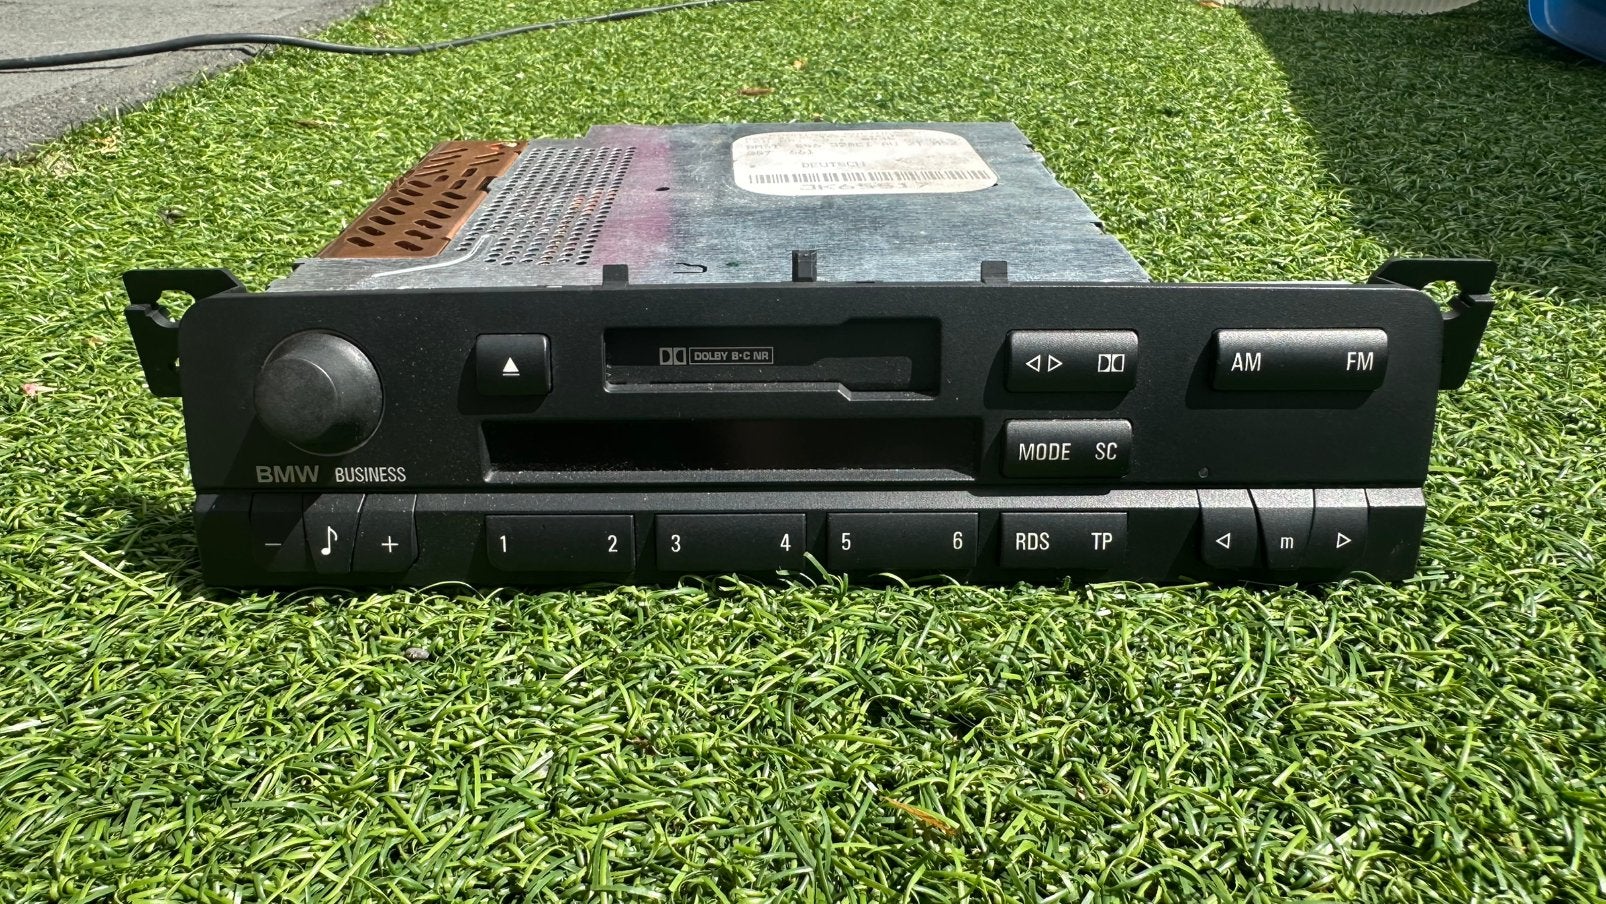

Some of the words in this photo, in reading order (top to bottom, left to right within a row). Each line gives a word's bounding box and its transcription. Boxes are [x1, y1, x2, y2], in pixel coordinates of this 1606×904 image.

[695, 351, 729, 361] DOLBY
[753, 351, 769, 361] NR
[1231, 352, 1262, 372] AM
[1346, 351, 1374, 371] FM
[1018, 442, 1072, 461] MODE
[1095, 441, 1118, 460] SC
[255, 465, 319, 483] BMW
[334, 466, 407, 483] BUSINESS
[499, 535, 507, 553] 1
[607, 534, 618, 553] 2
[671, 534, 681, 552] 3
[780, 533, 792, 552] 4
[841, 532, 851, 550] 5
[952, 531, 963, 550] 6
[1016, 532, 1050, 551] RDS
[1091, 532, 1113, 551] TP
[1280, 536, 1294, 549] m
